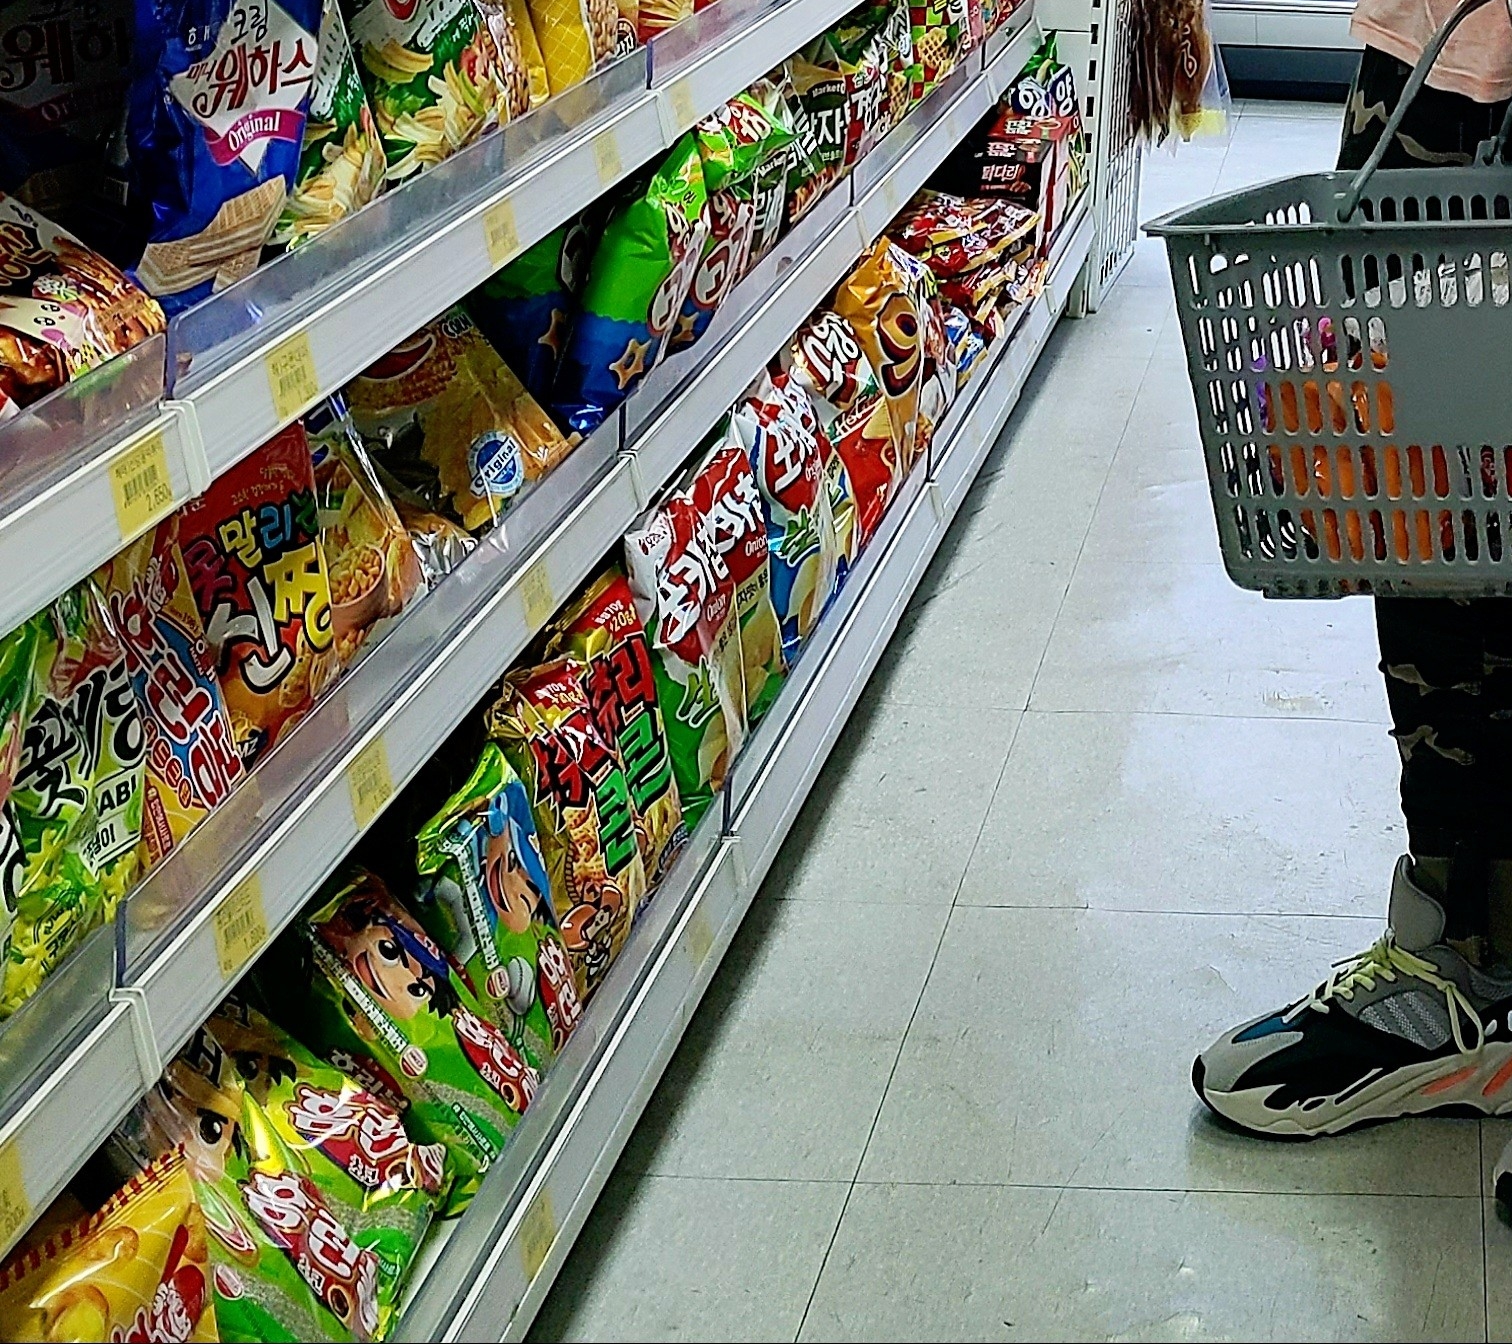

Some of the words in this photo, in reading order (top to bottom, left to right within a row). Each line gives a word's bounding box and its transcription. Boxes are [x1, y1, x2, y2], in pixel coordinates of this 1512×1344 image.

[192, 40, 314, 118] 웨하스
[228, 112, 282, 154] Original
[471, 439, 519, 497] Original
[205, 545, 335, 695] 신짱
